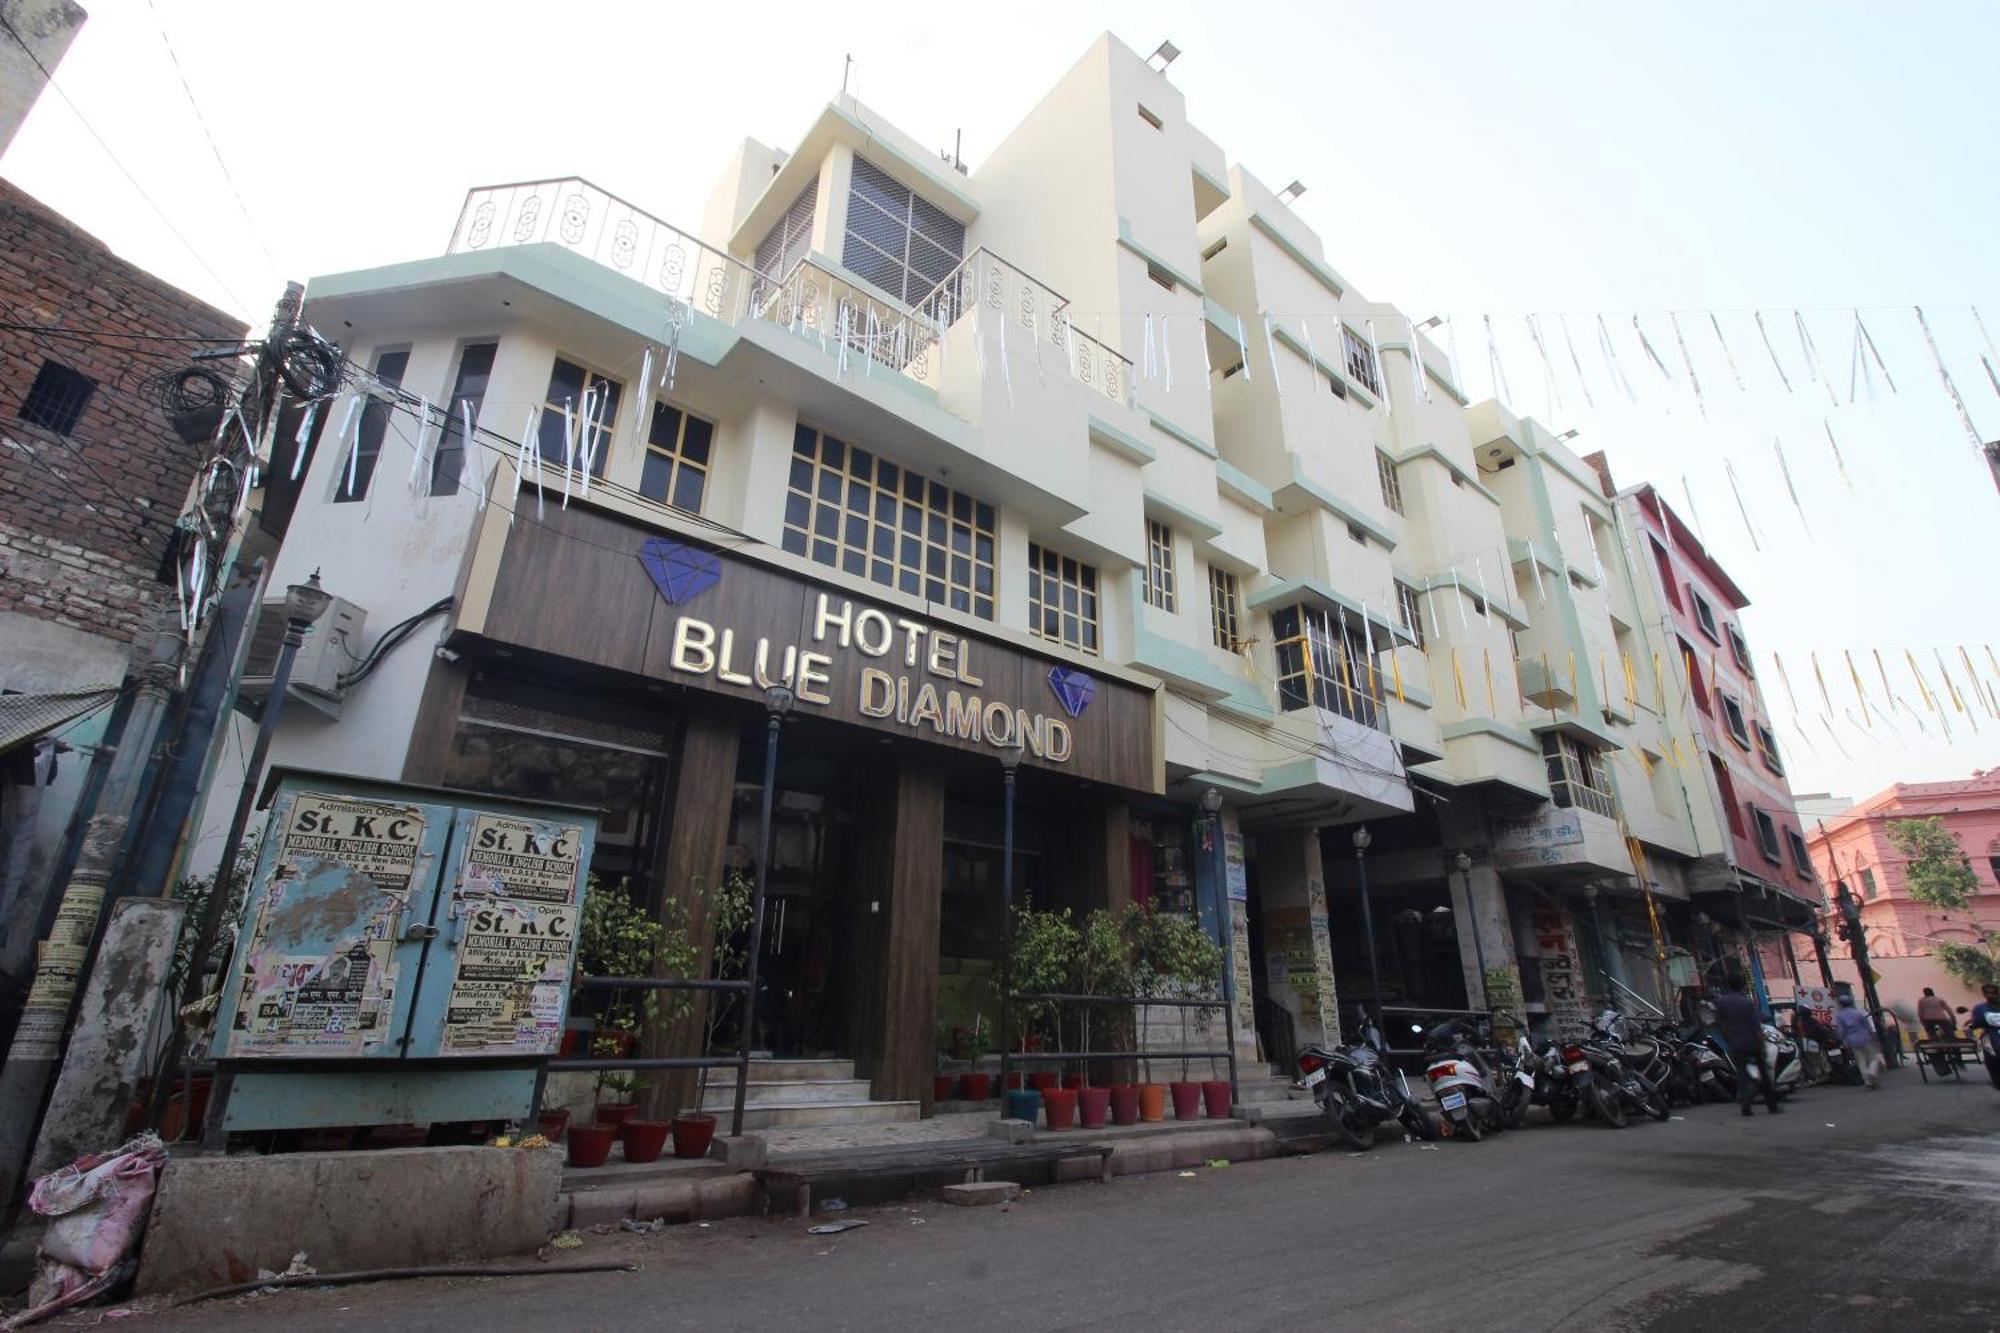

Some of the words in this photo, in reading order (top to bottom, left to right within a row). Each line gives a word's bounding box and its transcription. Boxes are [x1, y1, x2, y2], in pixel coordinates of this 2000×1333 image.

[813, 593, 984, 688] HOTEL
[669, 615, 833, 705] BLUE
[859, 666, 1072, 763] DIAMOND
[319, 802, 373, 814] Admission
[296, 810, 339, 834] St.
[287, 834, 338, 851] MEMORIAL
[339, 840, 378, 854] ENGLISH
[380, 843, 415, 857] SCHOOL
[478, 828, 513, 851] St.
[372, 857, 388, 865] New
[471, 850, 512, 866] MEMORIAL
[512, 856, 544, 870] ENGLISH
[545, 860, 574, 874] SCHOOL
[474, 911, 509, 933] St.
[538, 906, 563, 915] Open
[468, 935, 508, 949] MEMORIAL
[509, 938, 541, 951] ENGLISH
[541, 940, 570, 952] SCHOOL
